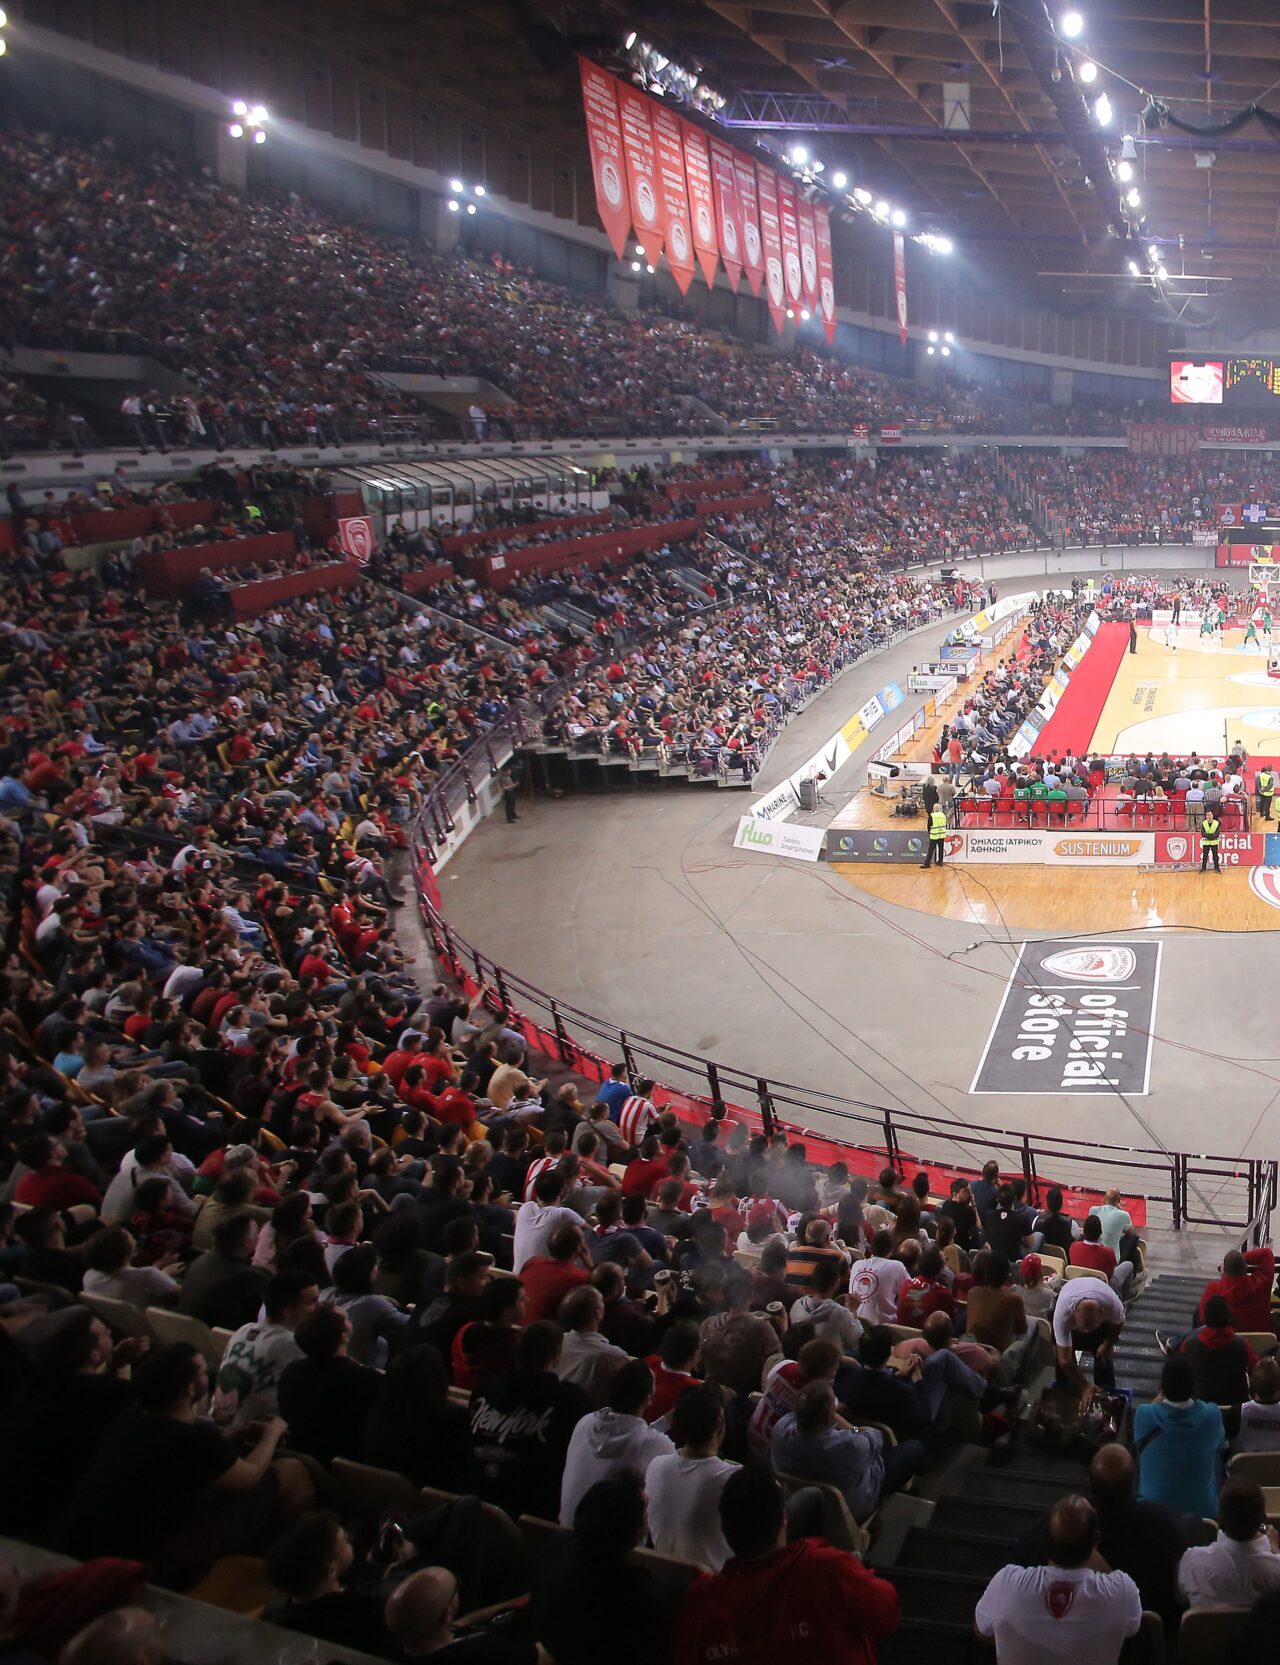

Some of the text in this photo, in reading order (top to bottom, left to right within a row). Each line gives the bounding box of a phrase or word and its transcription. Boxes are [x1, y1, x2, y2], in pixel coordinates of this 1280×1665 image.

[767, 793, 788, 814] MARINE
[780, 843, 815, 855] Smartphones
[970, 838, 1043, 847] ΟΜΙΛΟΣ ΙΑΤΡΙΚΟΥ
[1060, 842, 1130, 855] SUSTENIUM
[1011, 994, 1074, 1061] store
[1061, 994, 1129, 1087] official
